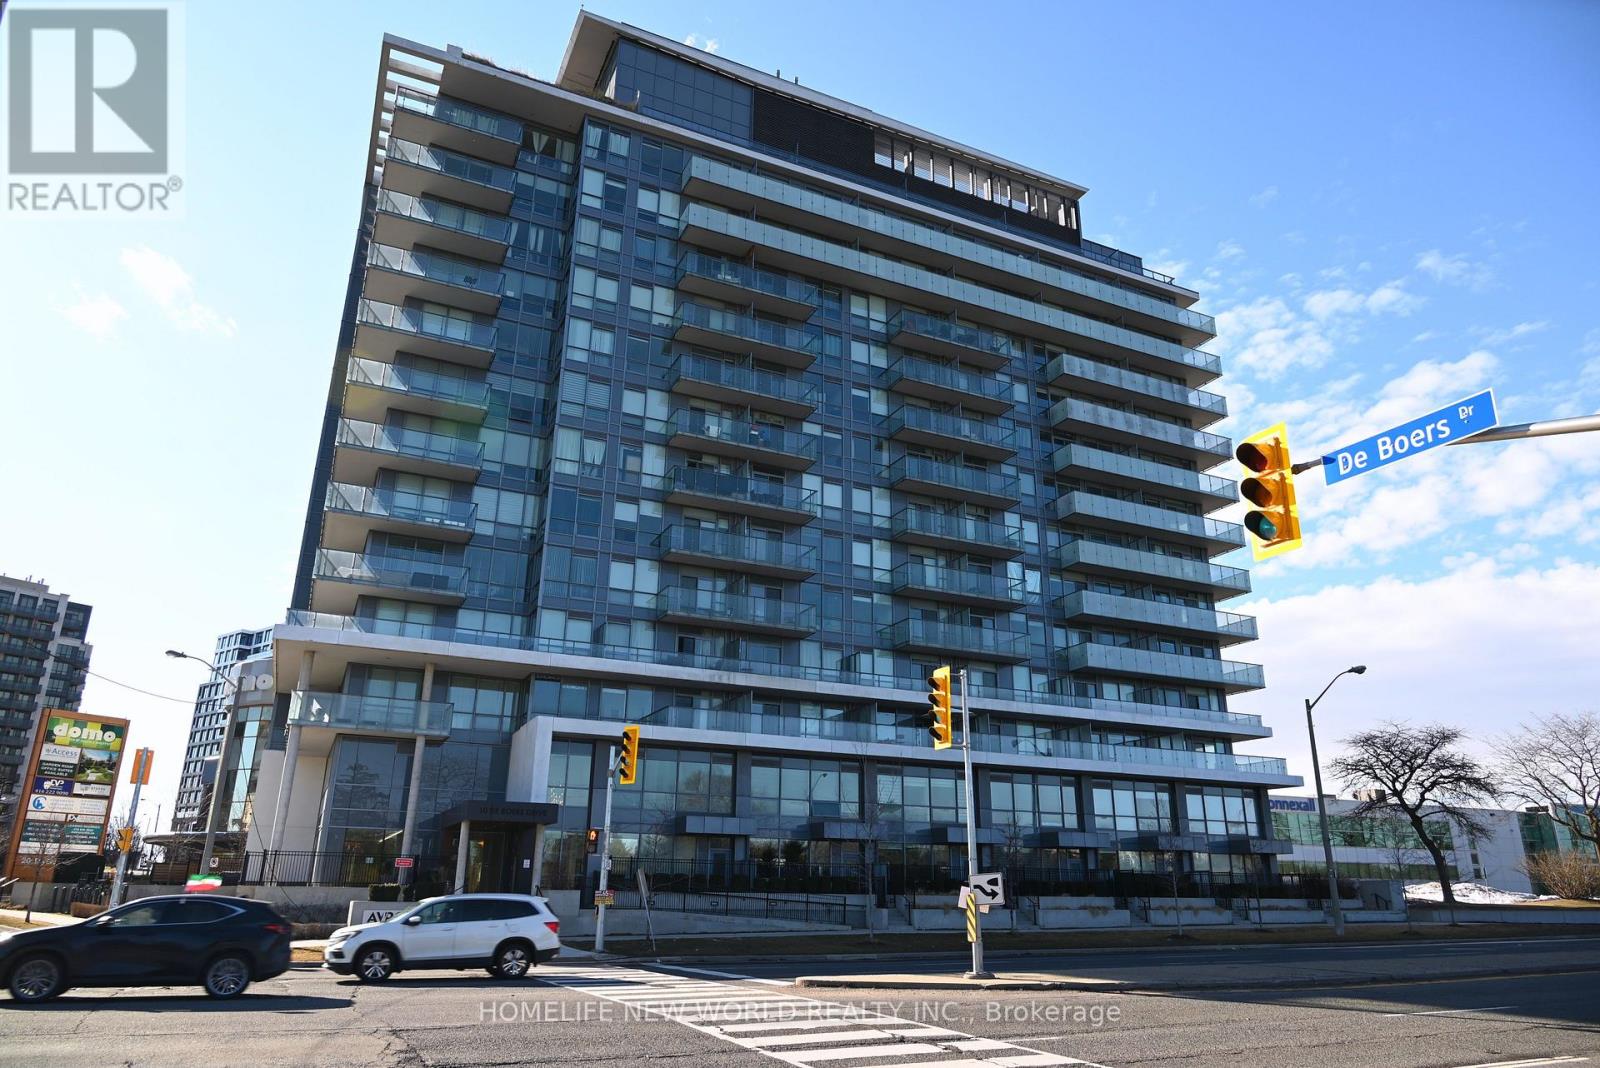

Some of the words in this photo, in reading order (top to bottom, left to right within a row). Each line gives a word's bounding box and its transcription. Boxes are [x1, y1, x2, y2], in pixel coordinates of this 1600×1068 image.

[1337, 449, 1368, 476] De
[1377, 418, 1451, 461] Boers
[1457, 404, 1474, 420] Dr
[53, 722, 116, 743] domo
[51, 747, 78, 757] Access
[1268, 798, 1316, 812] onnexall
[367, 911, 402, 923] AVR
